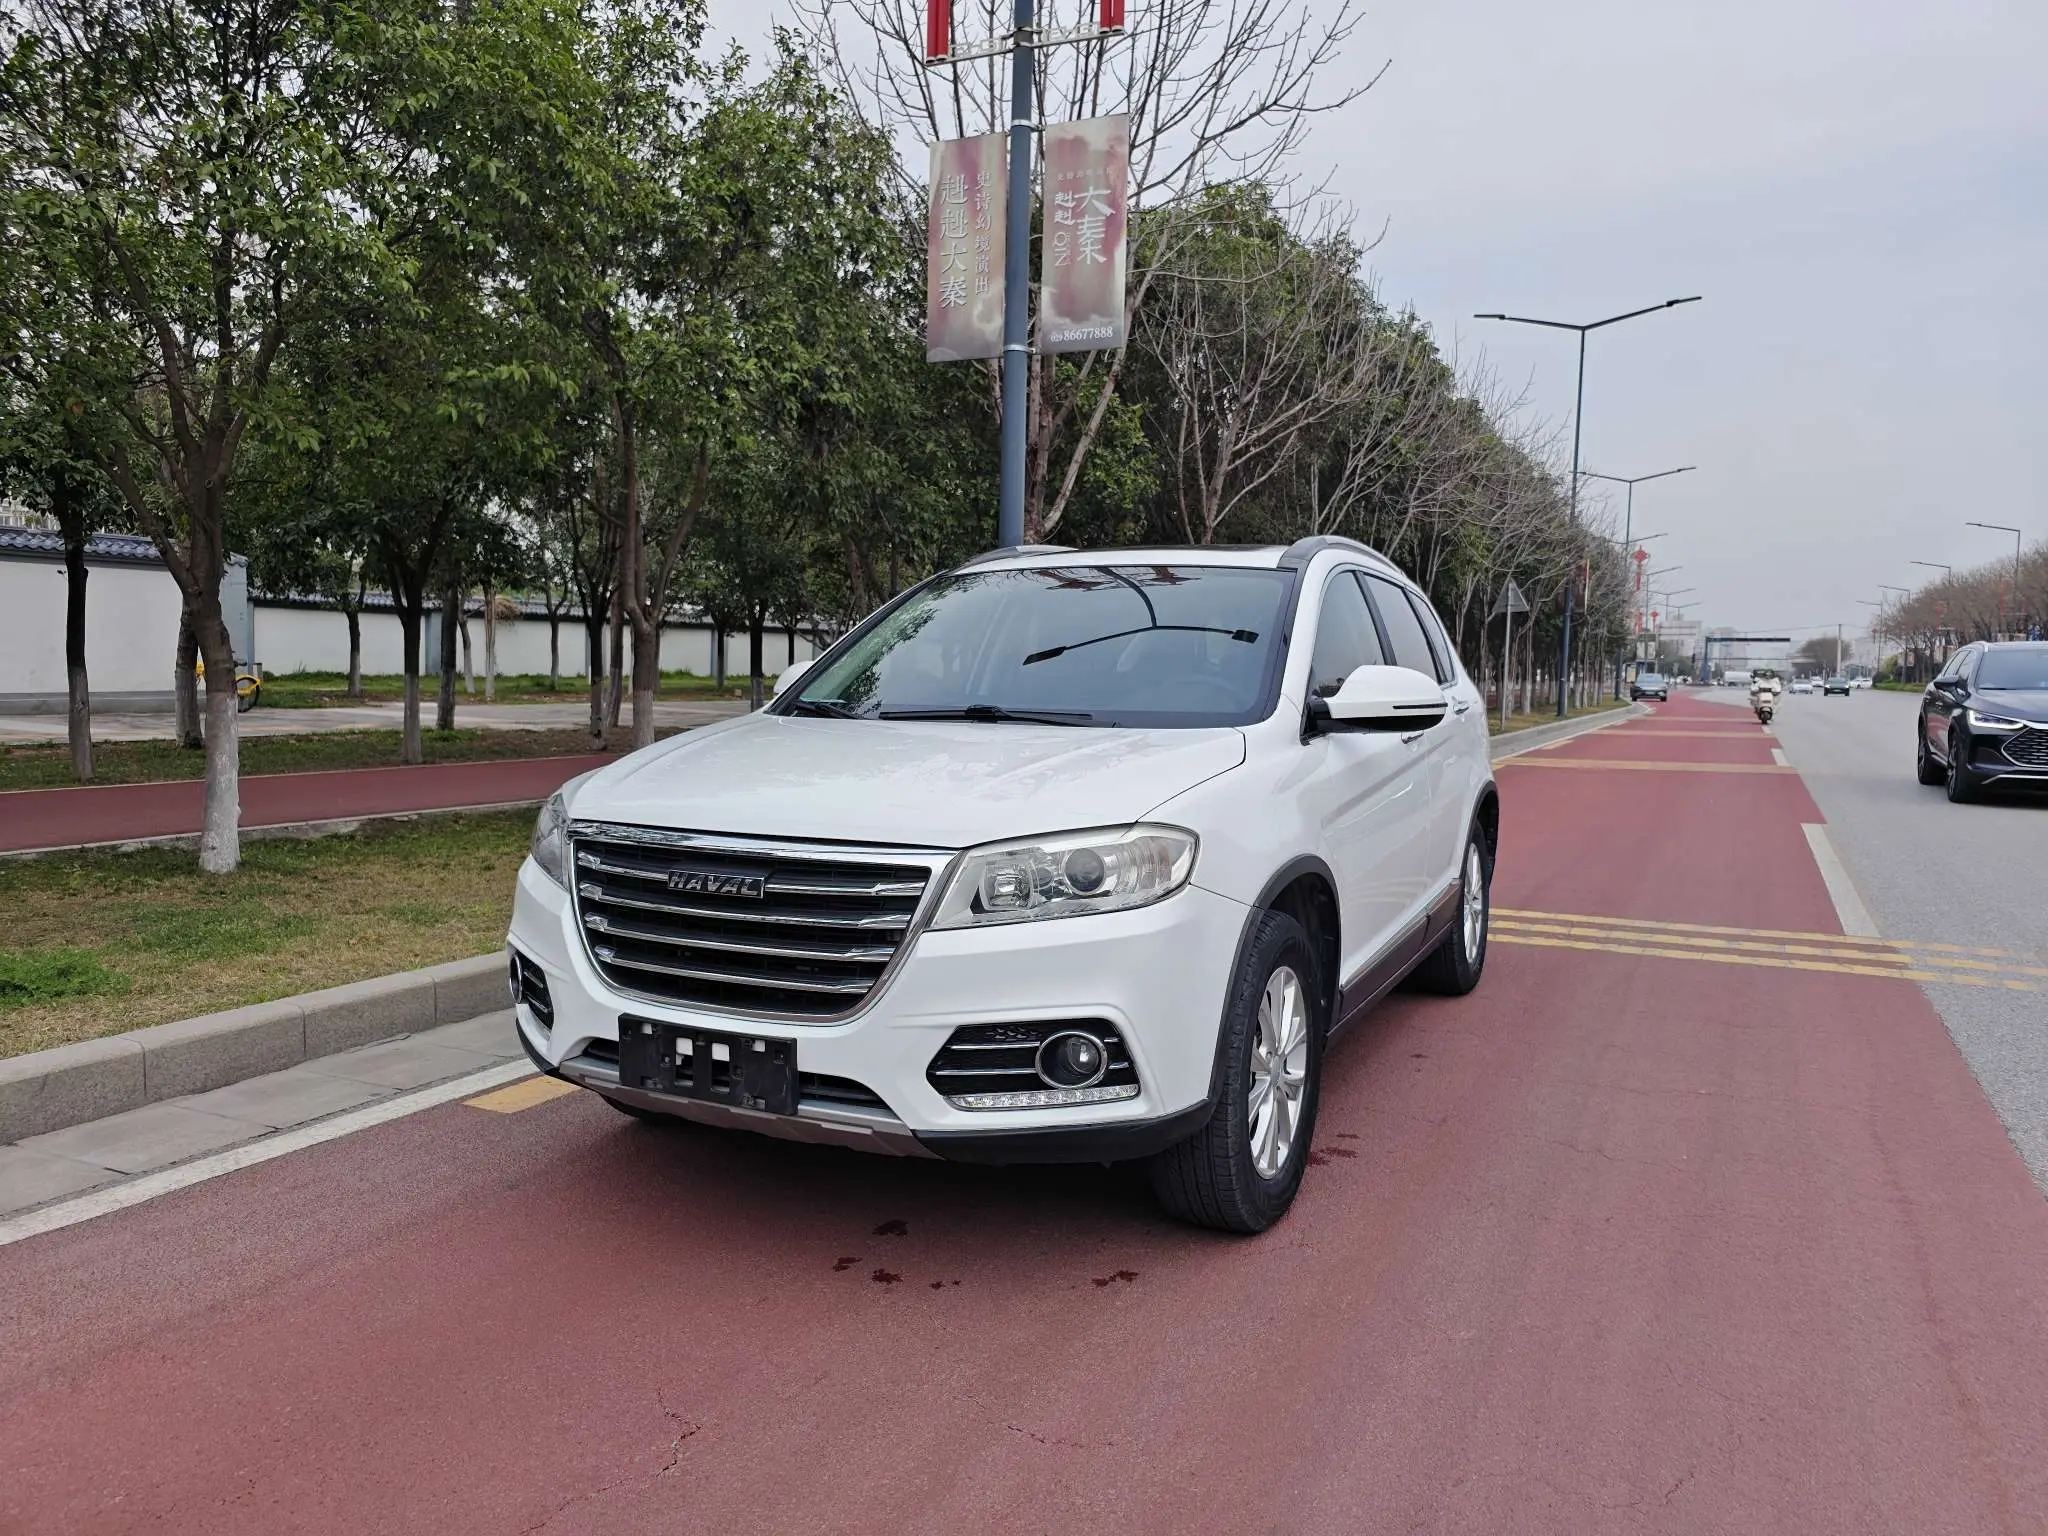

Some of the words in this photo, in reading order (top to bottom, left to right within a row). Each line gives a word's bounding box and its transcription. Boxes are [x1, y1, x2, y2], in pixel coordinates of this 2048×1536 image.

[940, 173, 969, 310] 赳赳大秦
[1073, 186, 1116, 265] 大秦
[668, 872, 760, 896] HAVAL
